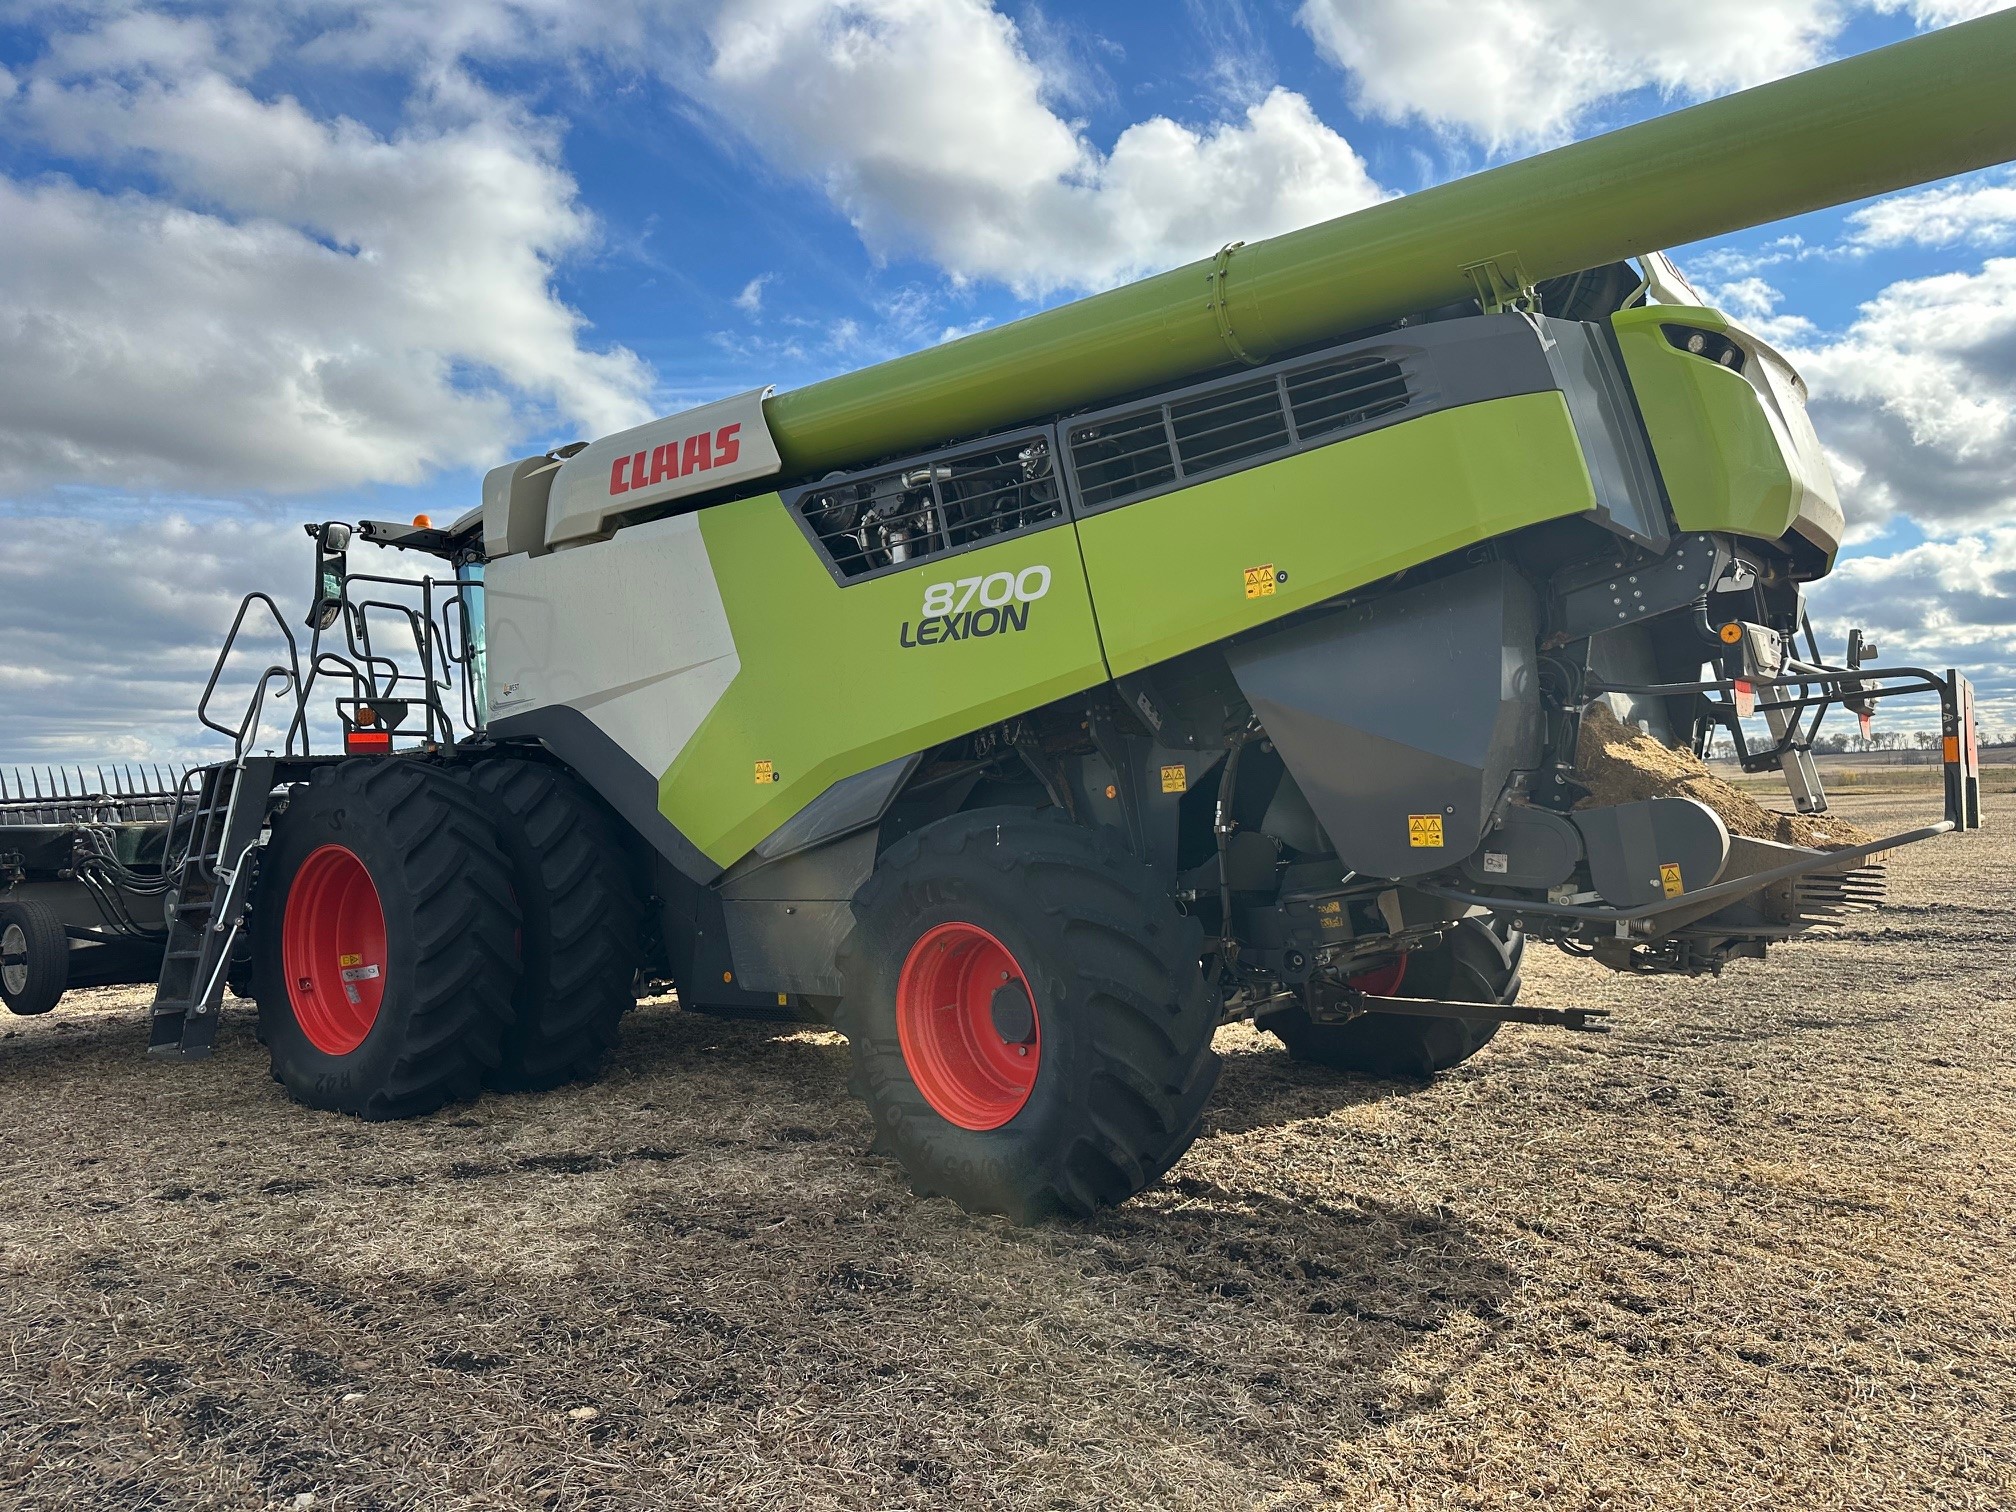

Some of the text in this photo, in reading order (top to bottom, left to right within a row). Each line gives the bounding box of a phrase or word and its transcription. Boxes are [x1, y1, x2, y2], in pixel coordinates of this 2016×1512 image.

[611, 423, 741, 495] CLAAS
[922, 565, 1051, 620] 8700
[900, 602, 1030, 648] LEXION
